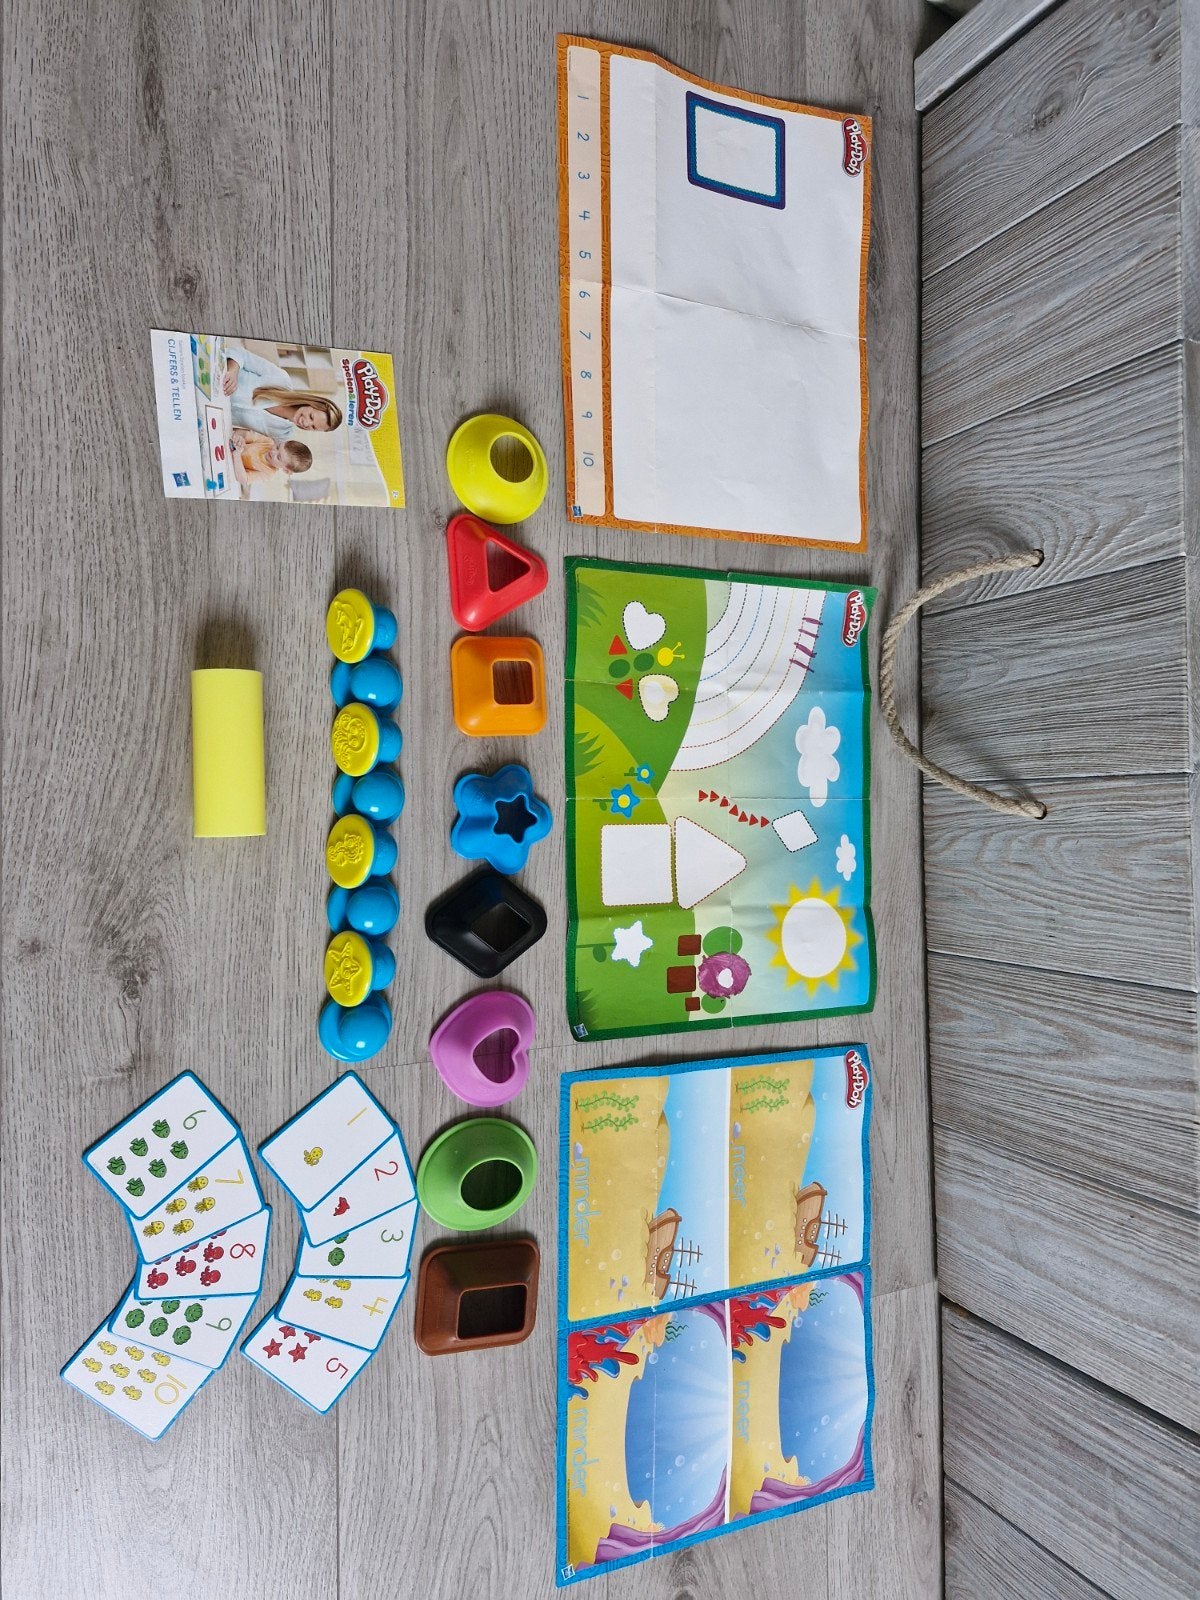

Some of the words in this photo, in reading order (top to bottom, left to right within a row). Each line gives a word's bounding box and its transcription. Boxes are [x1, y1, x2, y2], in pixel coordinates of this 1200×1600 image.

[577, 132, 590, 142] 2
[846, 121, 862, 173] Play-Doh
[577, 171, 590, 180] 3
[578, 210, 590, 220] 4
[579, 250, 591, 259] 5
[579, 290, 591, 299] 6
[579, 330, 592, 339] 7
[168, 339, 179, 376] CIJFERS
[580, 370, 592, 379] 8
[356, 362, 382, 425] Play-Doh
[172, 387, 182, 421] TELLEN
[581, 411, 593, 419] 9
[582, 452, 595, 467] 10
[845, 592, 864, 645] Play-Doh
[848, 1051, 864, 1106] Play-Doh
[183, 1109, 207, 1130] 6
[347, 1107, 368, 1126] 1
[215, 1169, 245, 1186] 7
[373, 1161, 399, 1181] 2
[732, 1145, 748, 1208] meer
[574, 1156, 601, 1248] minder
[381, 1228, 404, 1243] 3
[230, 1243, 256, 1260] 8
[362, 1296, 389, 1317] 4
[205, 1317, 233, 1331] 9
[325, 1357, 349, 1380] 5
[154, 1374, 187, 1406] 10
[735, 1381, 751, 1443] meer
[572, 1408, 600, 1497] minder
